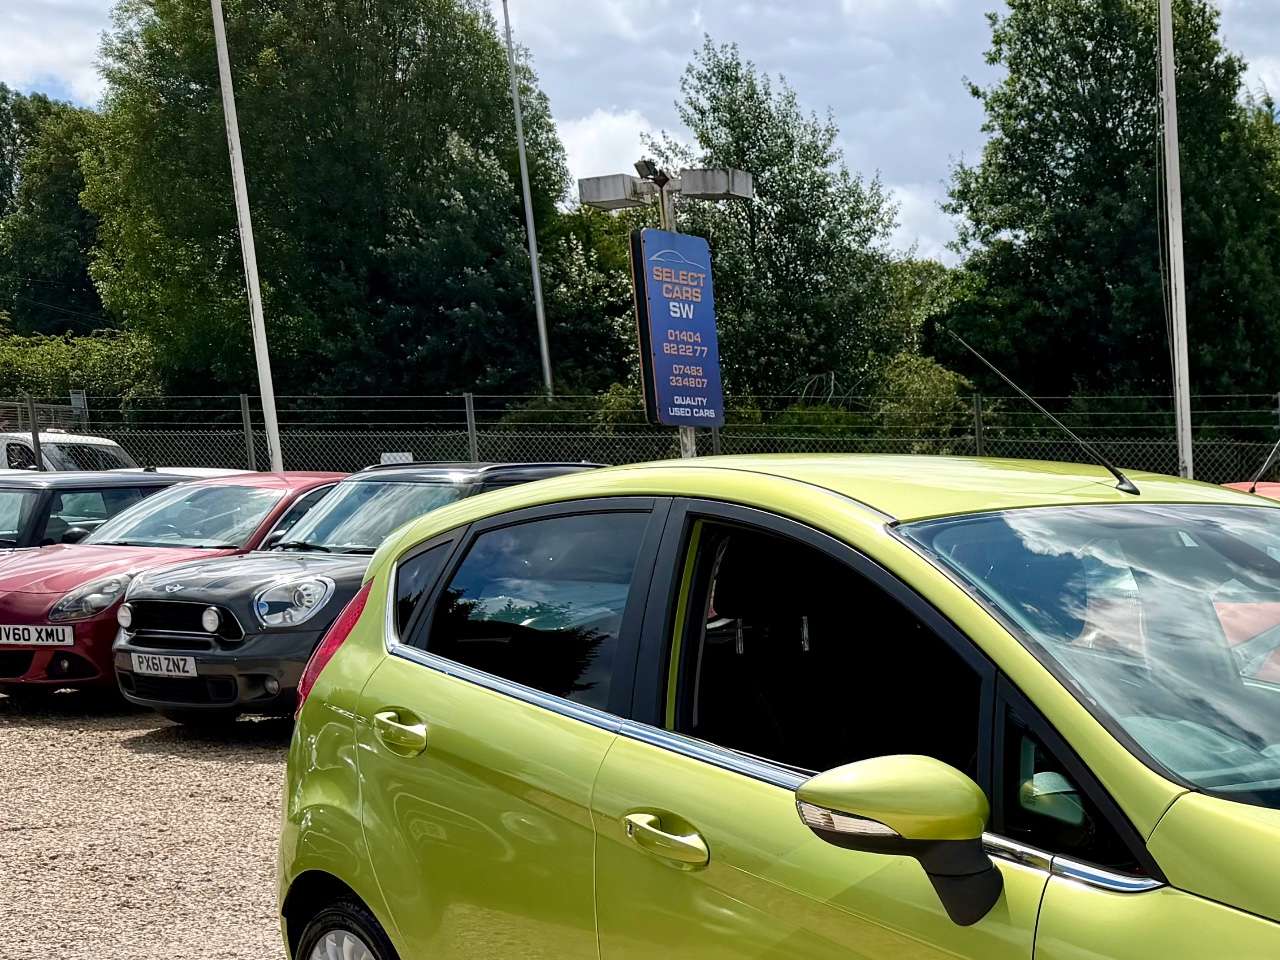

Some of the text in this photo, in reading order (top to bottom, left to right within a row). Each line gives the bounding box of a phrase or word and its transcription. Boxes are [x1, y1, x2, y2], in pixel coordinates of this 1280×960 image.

[653, 266, 706, 287] SELECT
[662, 284, 702, 303] CARS
[669, 301, 694, 319] SW
[667, 329, 701, 343] 01404
[673, 395, 708, 406] QUALITY
[668, 407, 716, 418] USED CARS
[0, 627, 66, 642] V60 XMU
[138, 655, 190, 673] PX61 ZNZ
